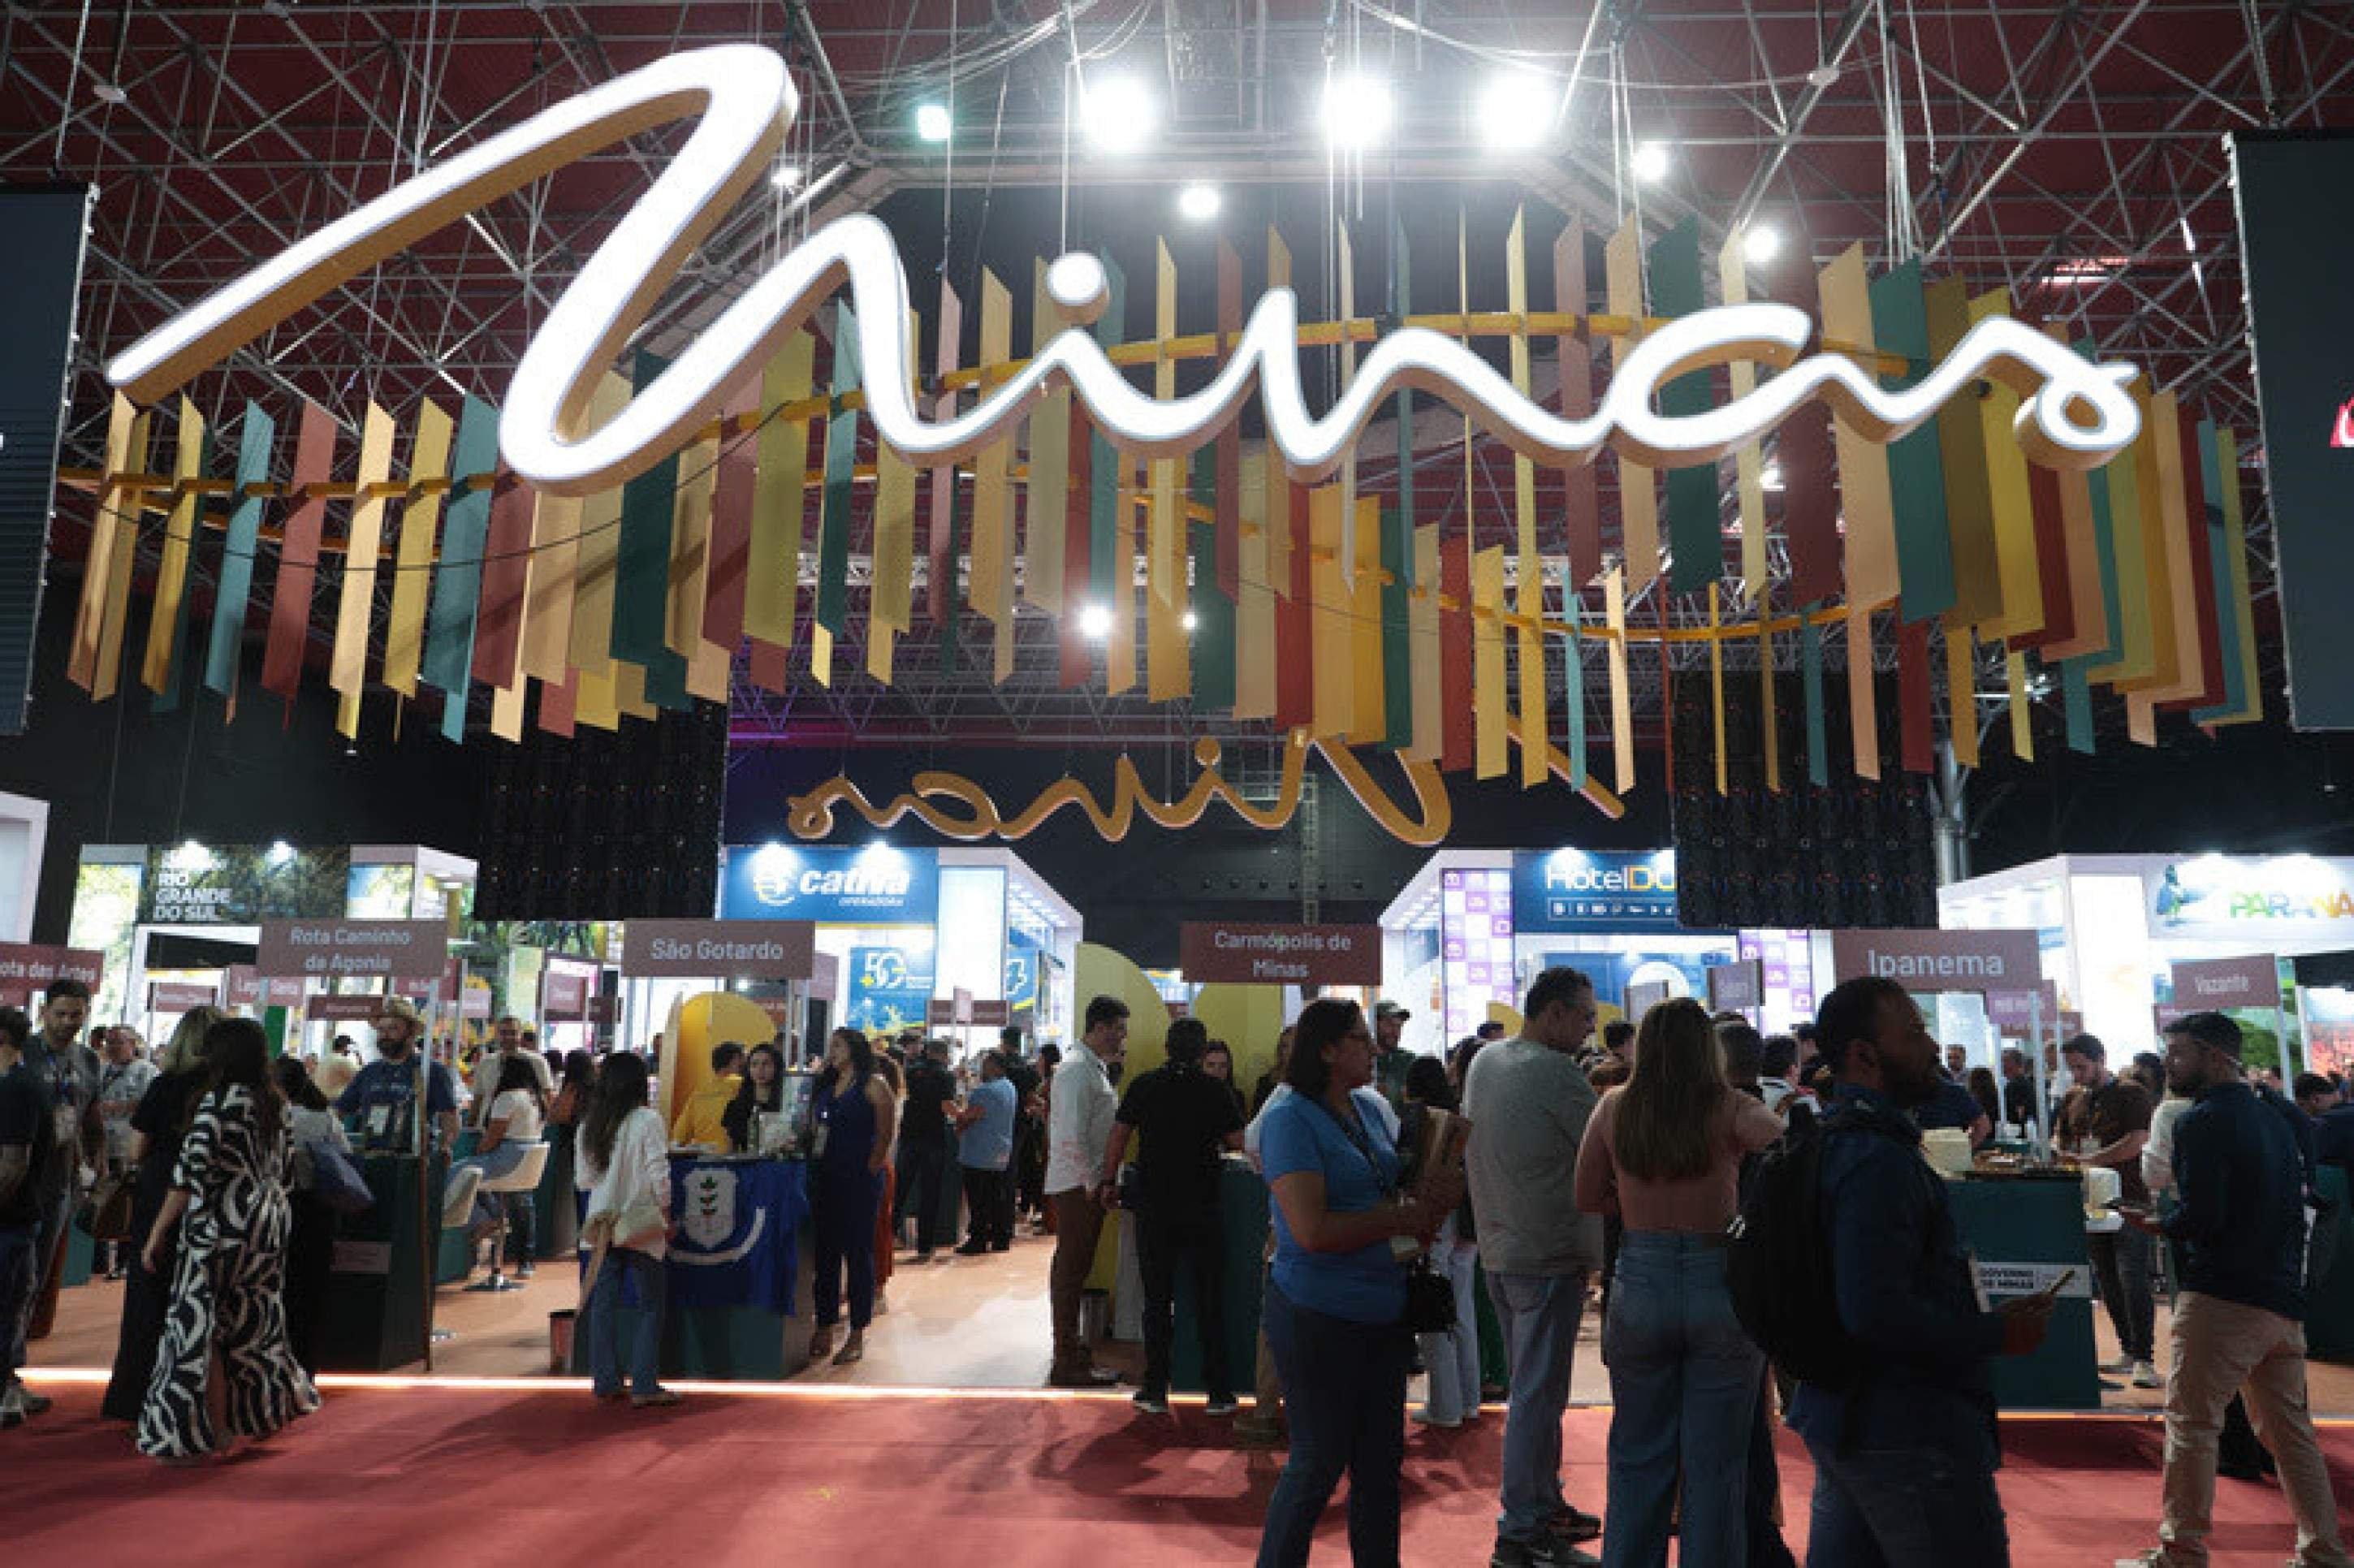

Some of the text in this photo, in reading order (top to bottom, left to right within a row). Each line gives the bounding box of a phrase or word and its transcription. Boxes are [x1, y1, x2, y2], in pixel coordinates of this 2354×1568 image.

[107, 42, 2139, 487] Minas
[158, 872, 189, 887] RIO
[155, 888, 232, 904] GRANDE
[153, 905, 222, 921] DO SUL
[291, 927, 412, 945] Rota Caminho
[1214, 929, 1351, 952] Carmópolis de
[652, 937, 784, 961] São Gotardo
[0, 959, 24, 978] ota
[304, 952, 391, 974] da Agonia
[1253, 958, 1310, 978] Minas
[1868, 949, 2004, 978] Ipanema
